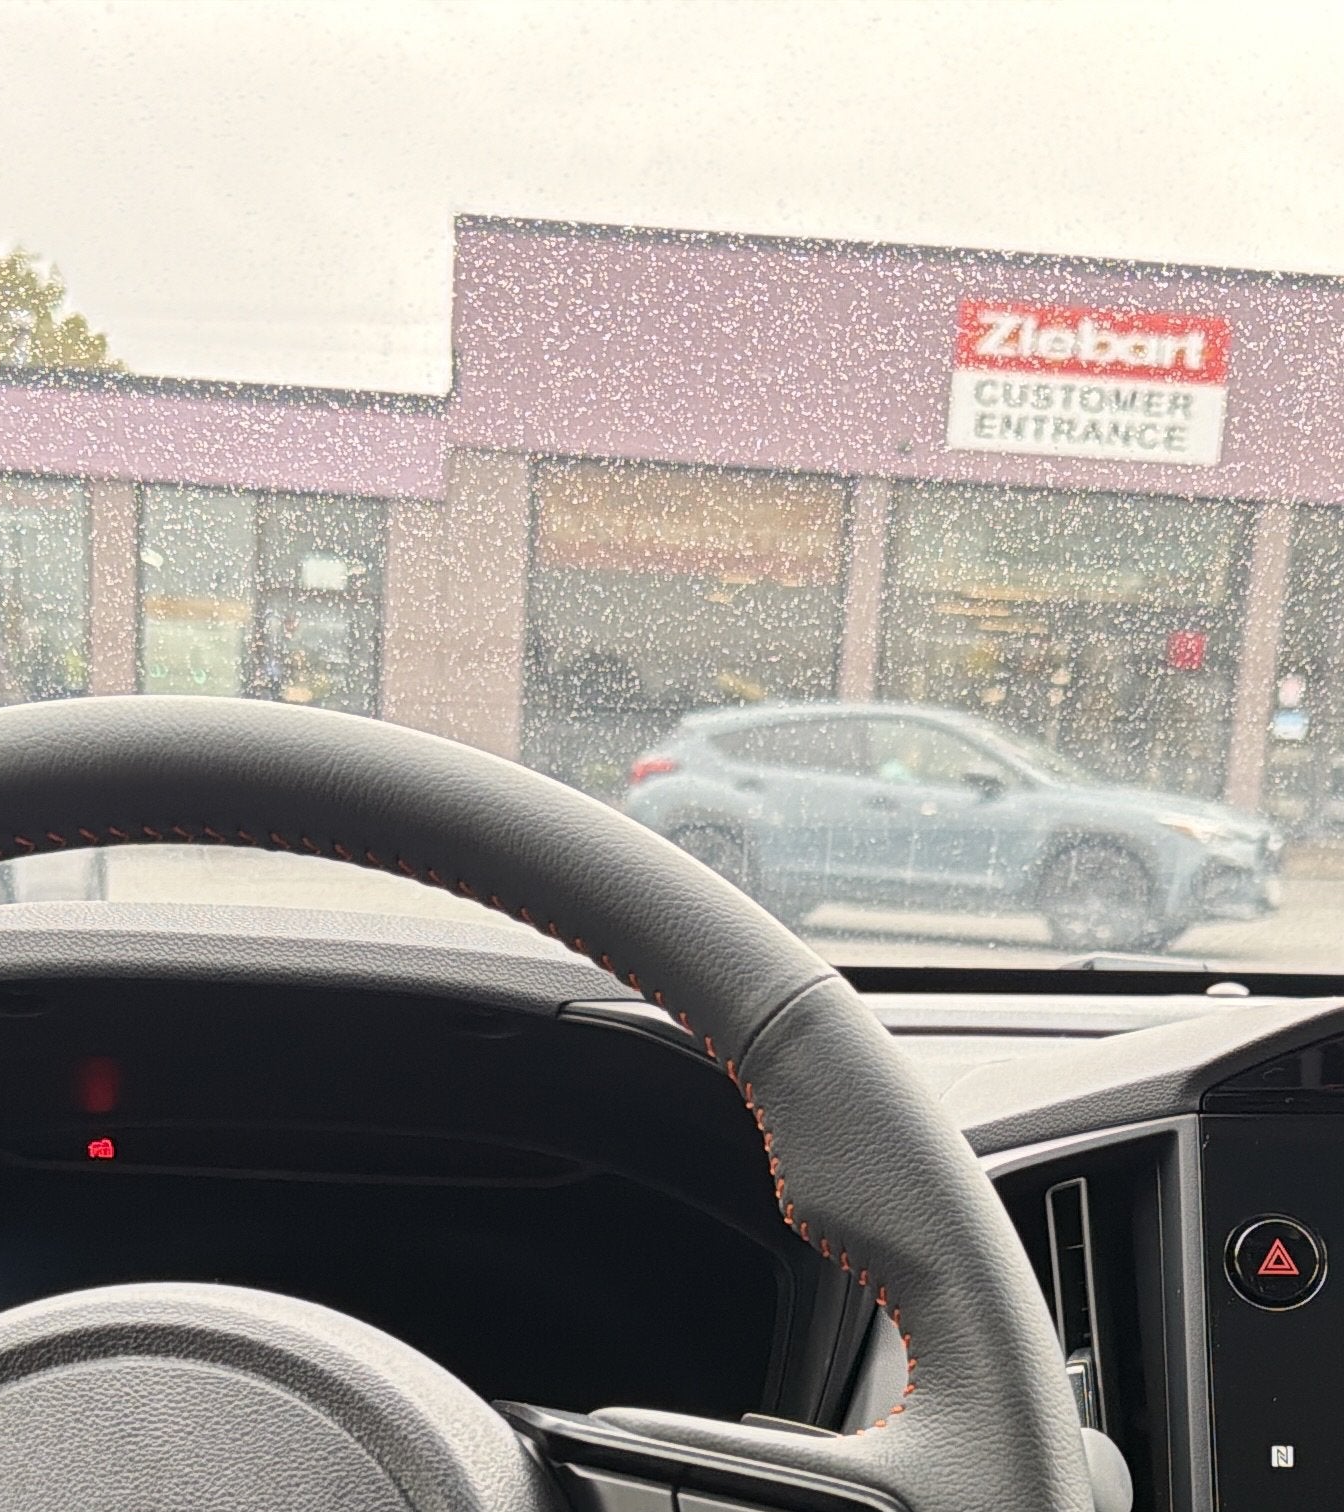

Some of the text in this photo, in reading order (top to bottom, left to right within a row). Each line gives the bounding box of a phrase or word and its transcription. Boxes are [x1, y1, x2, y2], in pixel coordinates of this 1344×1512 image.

[973, 309, 1207, 371] Ziebart
[973, 378, 1196, 420] CUSTOMER
[973, 412, 1190, 454] ENTRANCE
